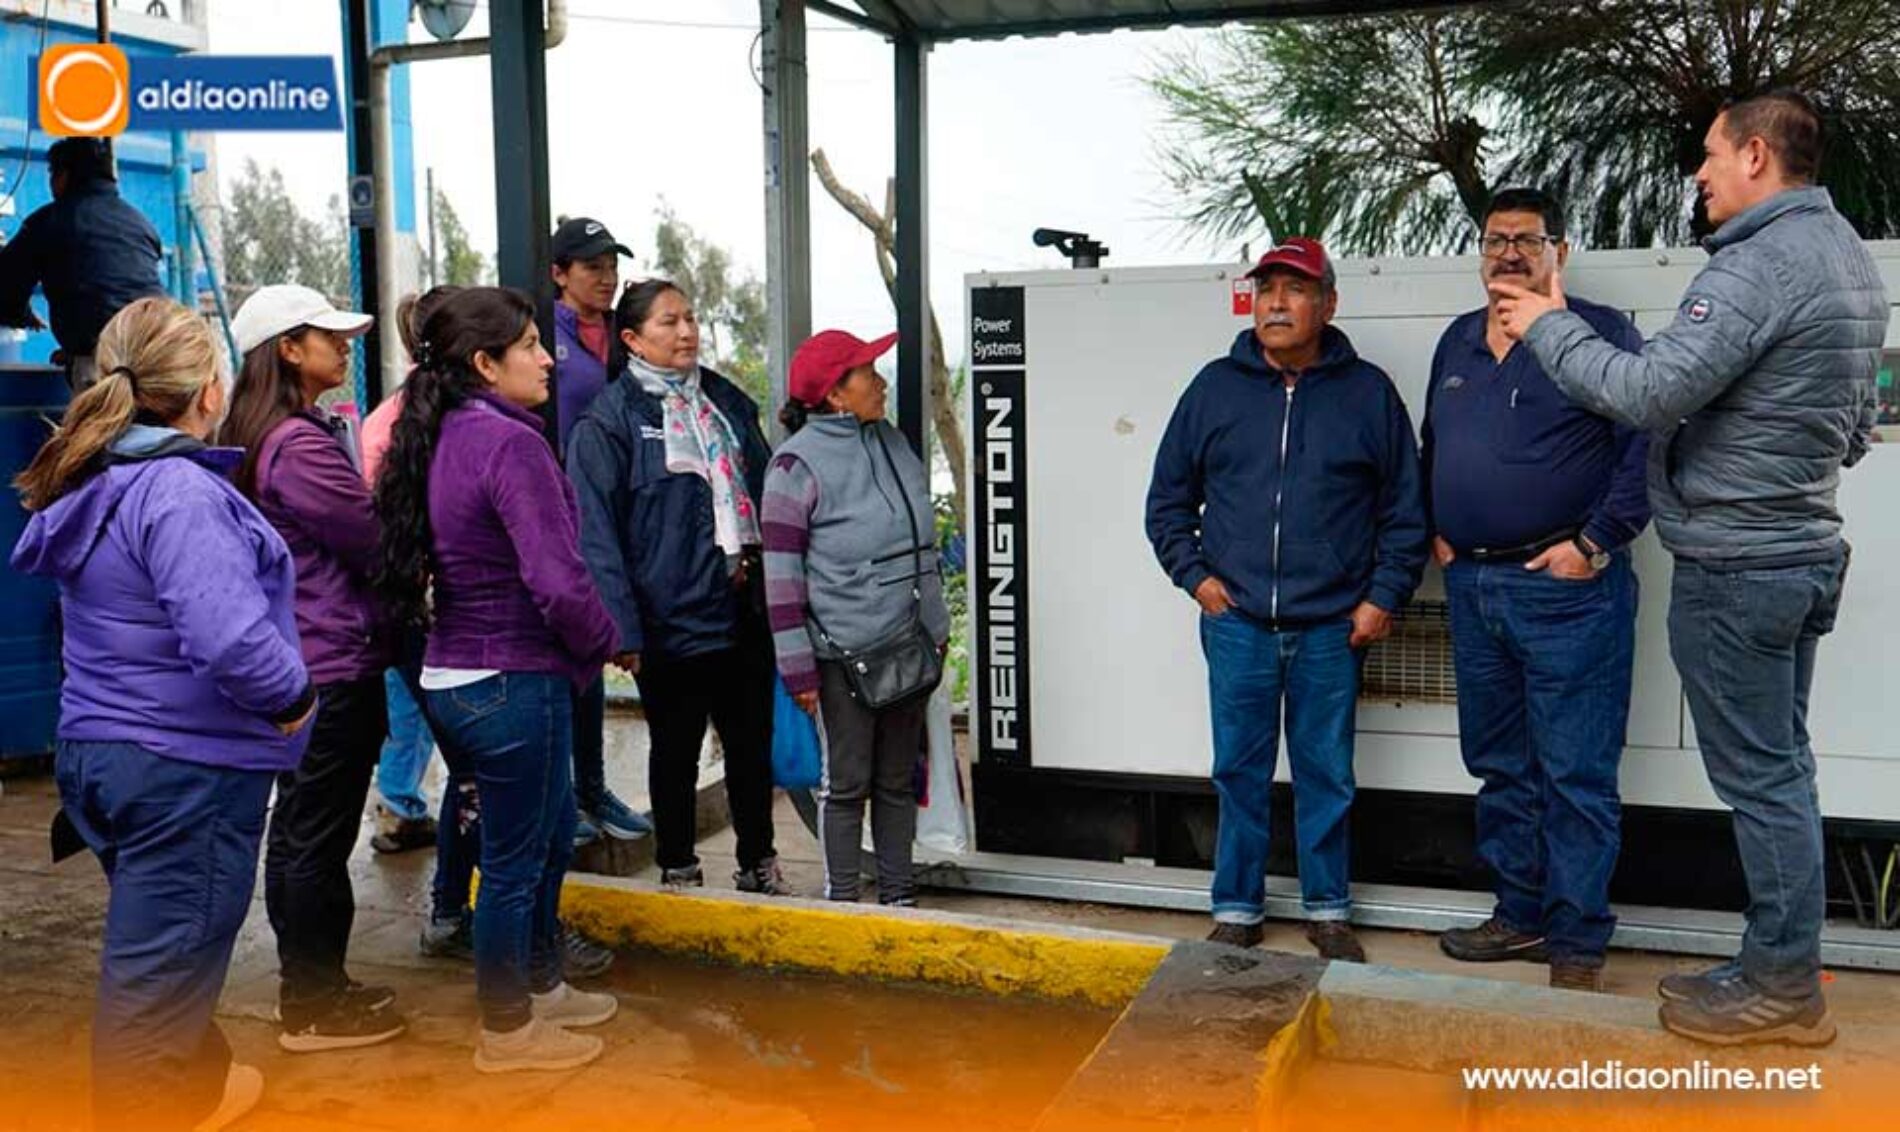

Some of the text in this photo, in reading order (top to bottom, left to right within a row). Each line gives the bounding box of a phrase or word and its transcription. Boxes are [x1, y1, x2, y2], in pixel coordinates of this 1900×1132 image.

[974, 316, 1012, 333] Power
[974, 340, 1022, 360] Systems
[986, 397, 1018, 750] REMINGTON
